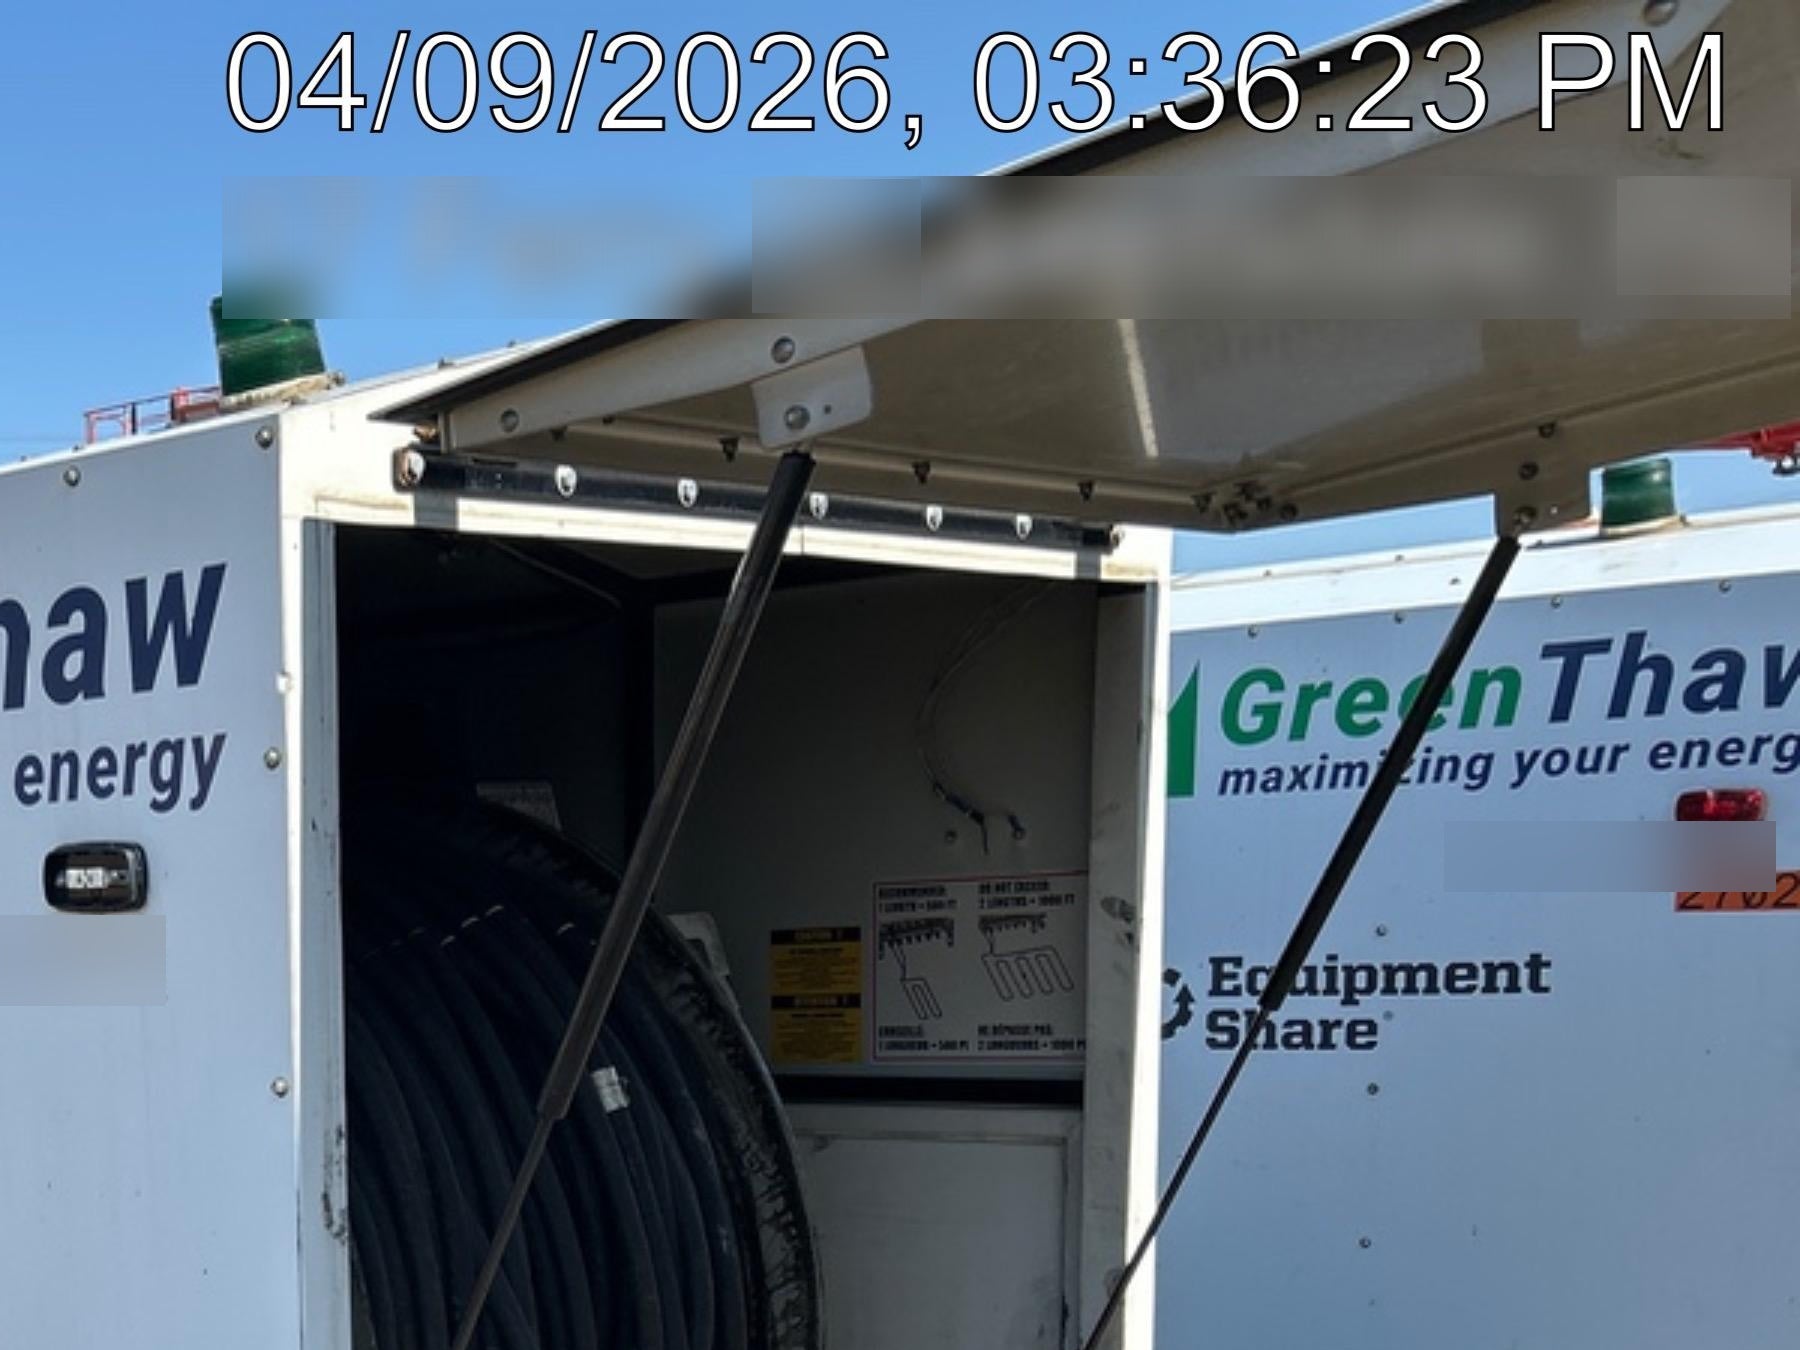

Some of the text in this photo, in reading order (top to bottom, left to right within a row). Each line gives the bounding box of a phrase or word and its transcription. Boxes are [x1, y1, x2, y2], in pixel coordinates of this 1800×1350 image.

[14, 732, 227, 813] energy
[1509, 739, 1630, 790] your
[1205, 1009, 1379, 1050] Share
